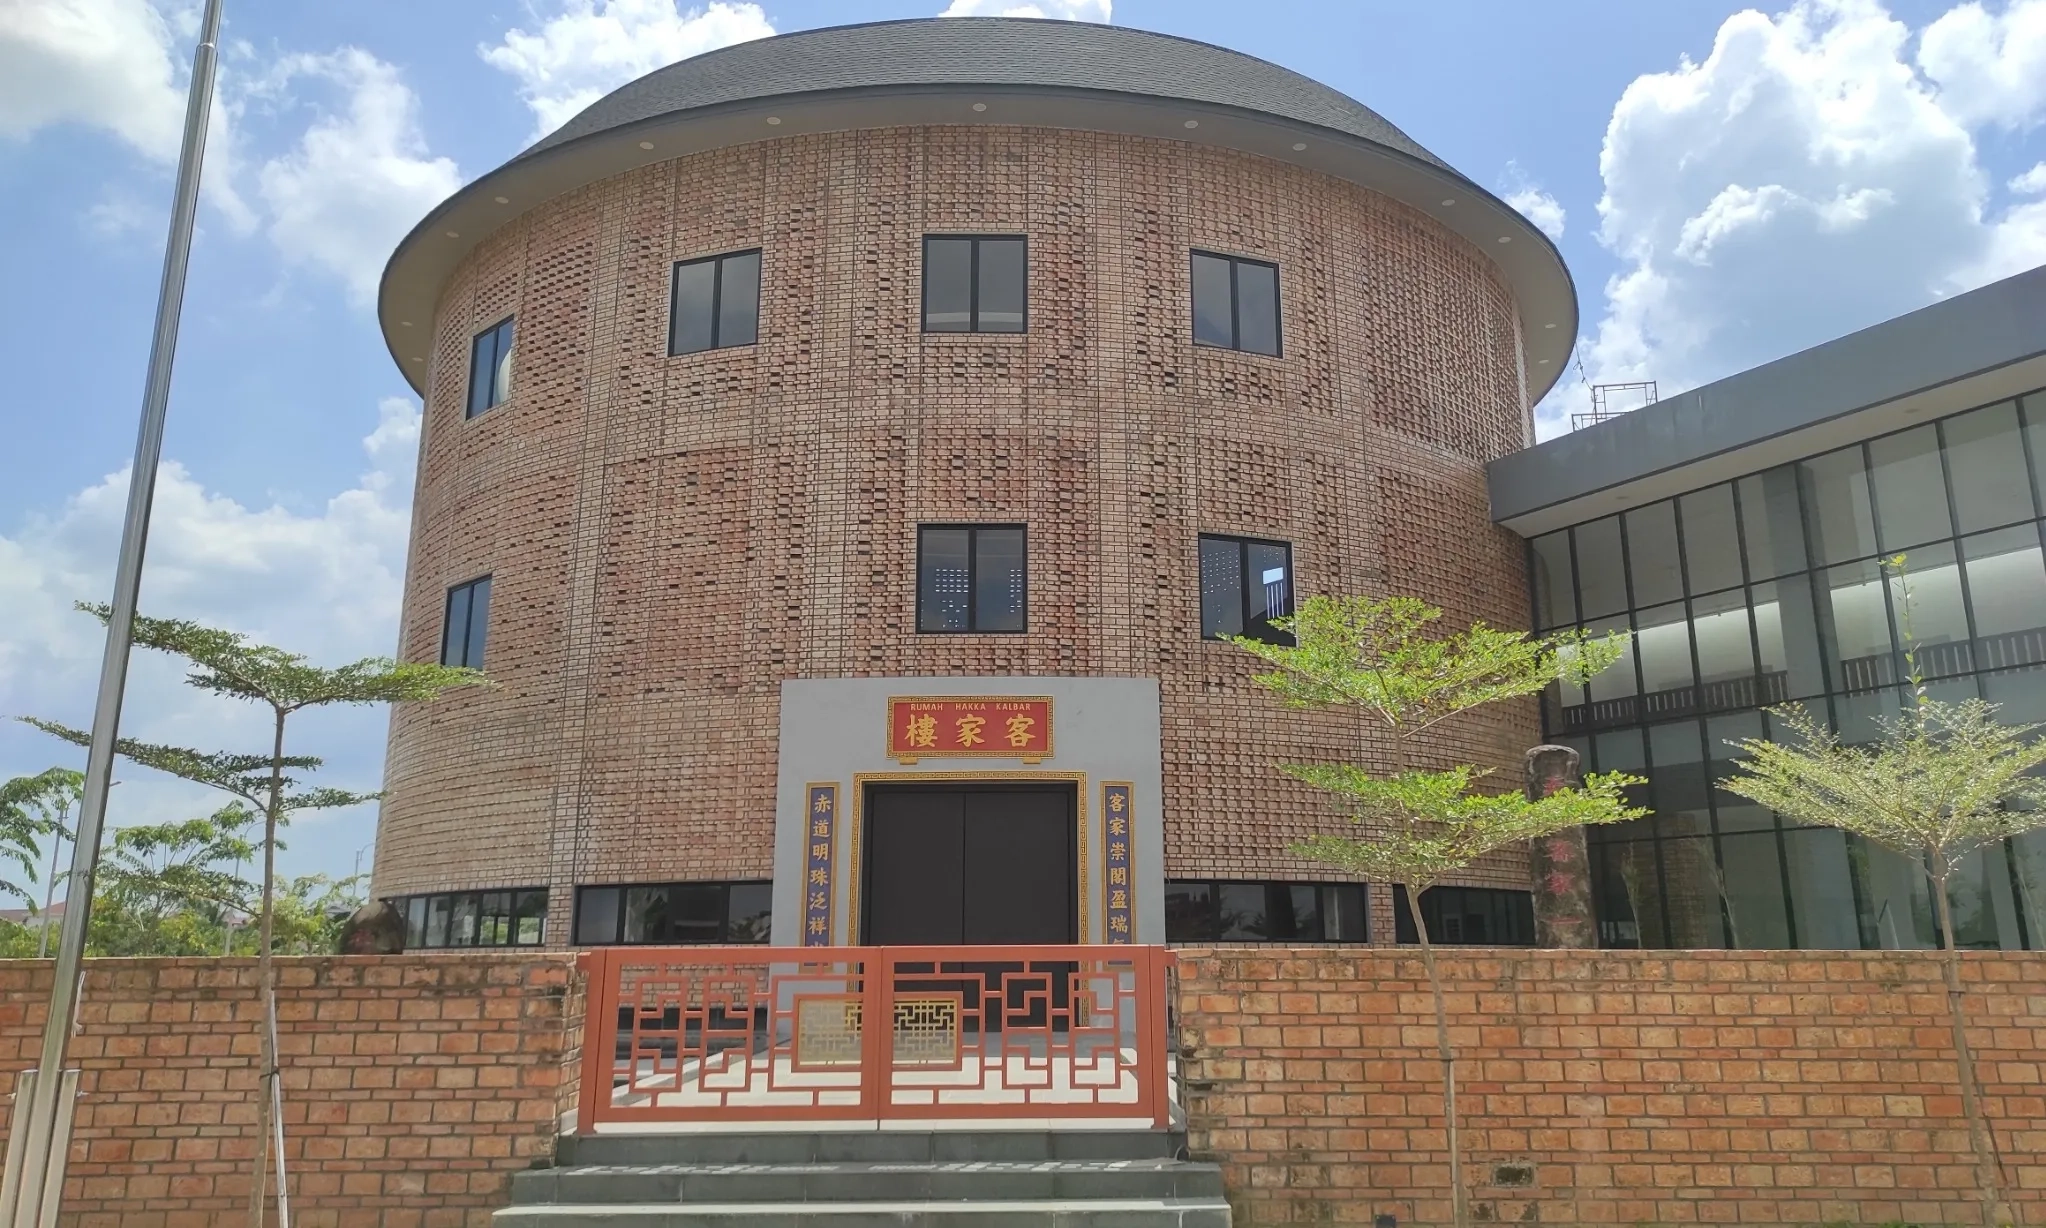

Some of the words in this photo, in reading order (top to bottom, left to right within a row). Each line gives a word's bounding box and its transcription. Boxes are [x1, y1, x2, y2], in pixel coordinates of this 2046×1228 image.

[910, 703, 943, 712] RUMAH
[955, 703, 986, 711] HAKKA
[996, 703, 1031, 711] KALBAR
